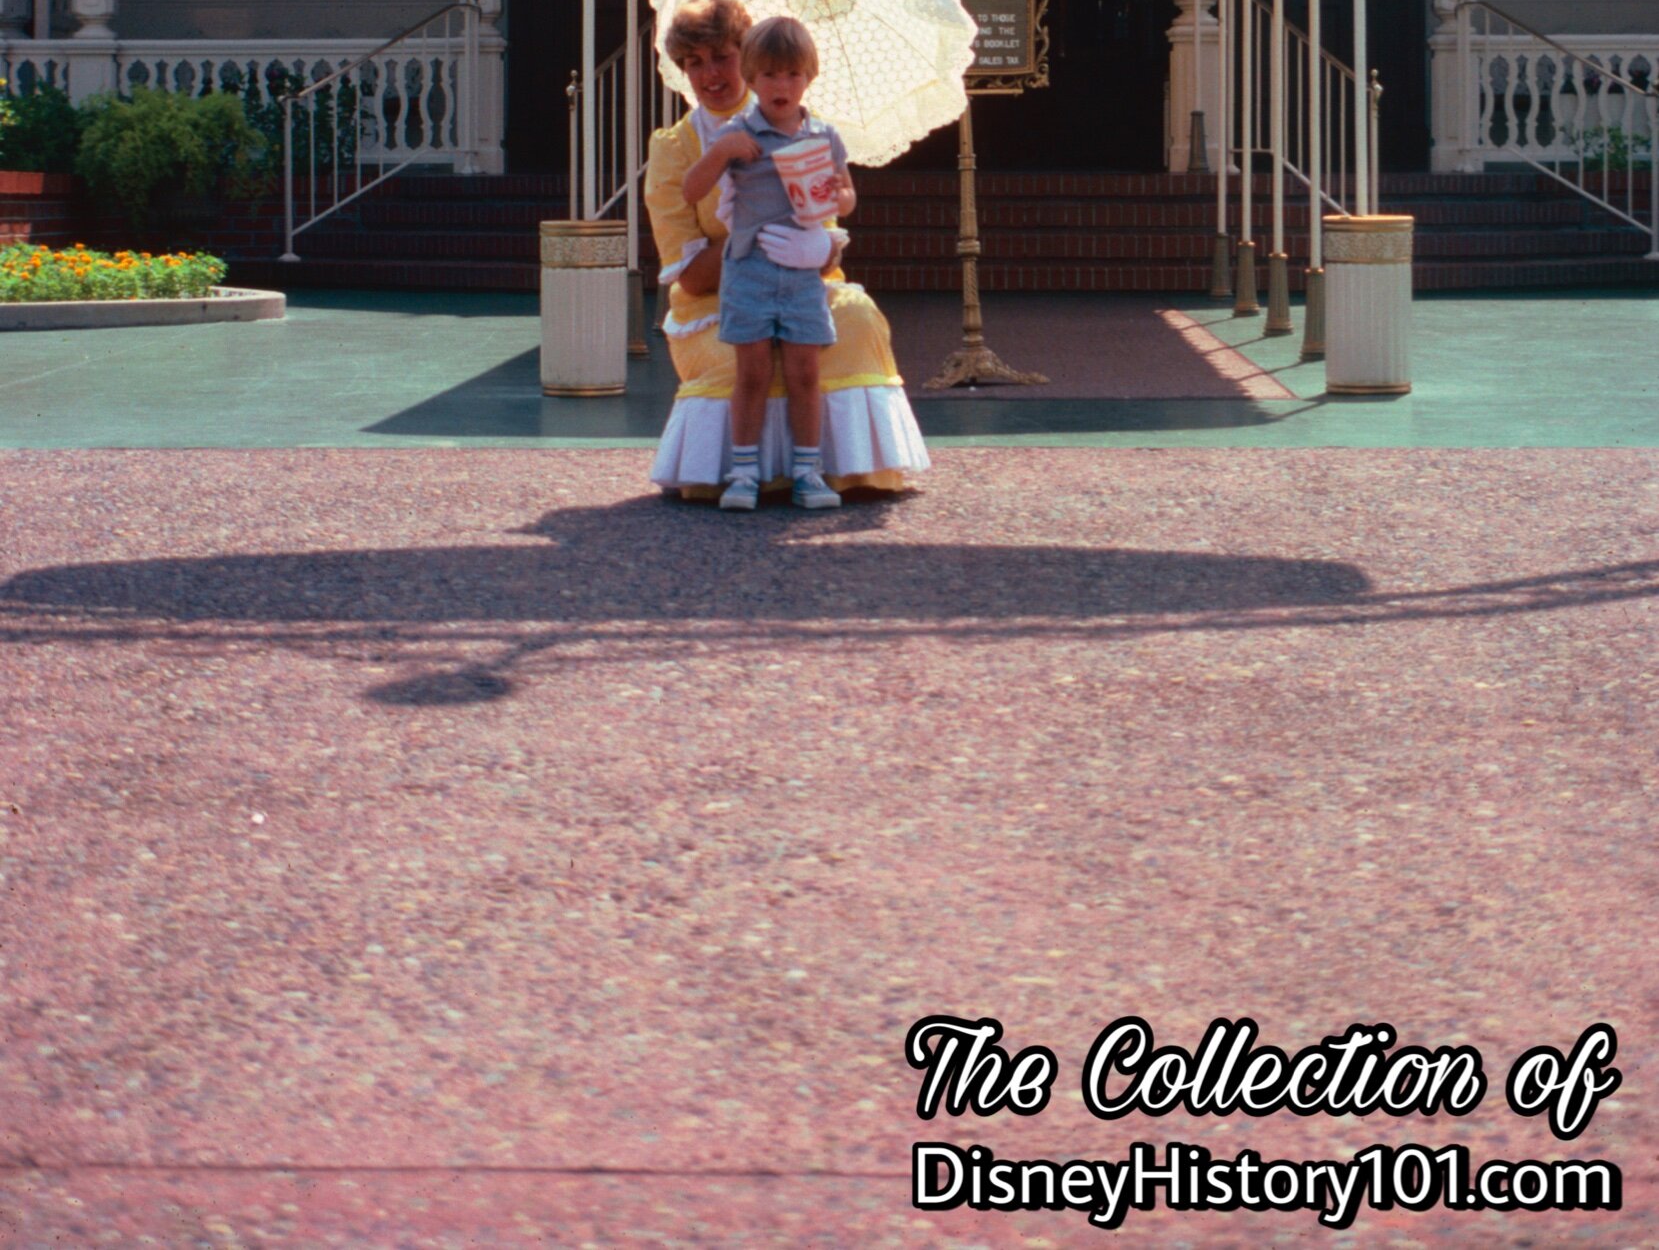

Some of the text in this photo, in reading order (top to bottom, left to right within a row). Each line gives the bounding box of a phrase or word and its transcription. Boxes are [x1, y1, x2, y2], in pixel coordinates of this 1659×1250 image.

[977, 14, 988, 23] TO
[991, 14, 1016, 23] THOSE
[999, 27, 1015, 35] THE
[984, 39, 1020, 48] BOOKLET
[979, 56, 1019, 65] SALES TAX
